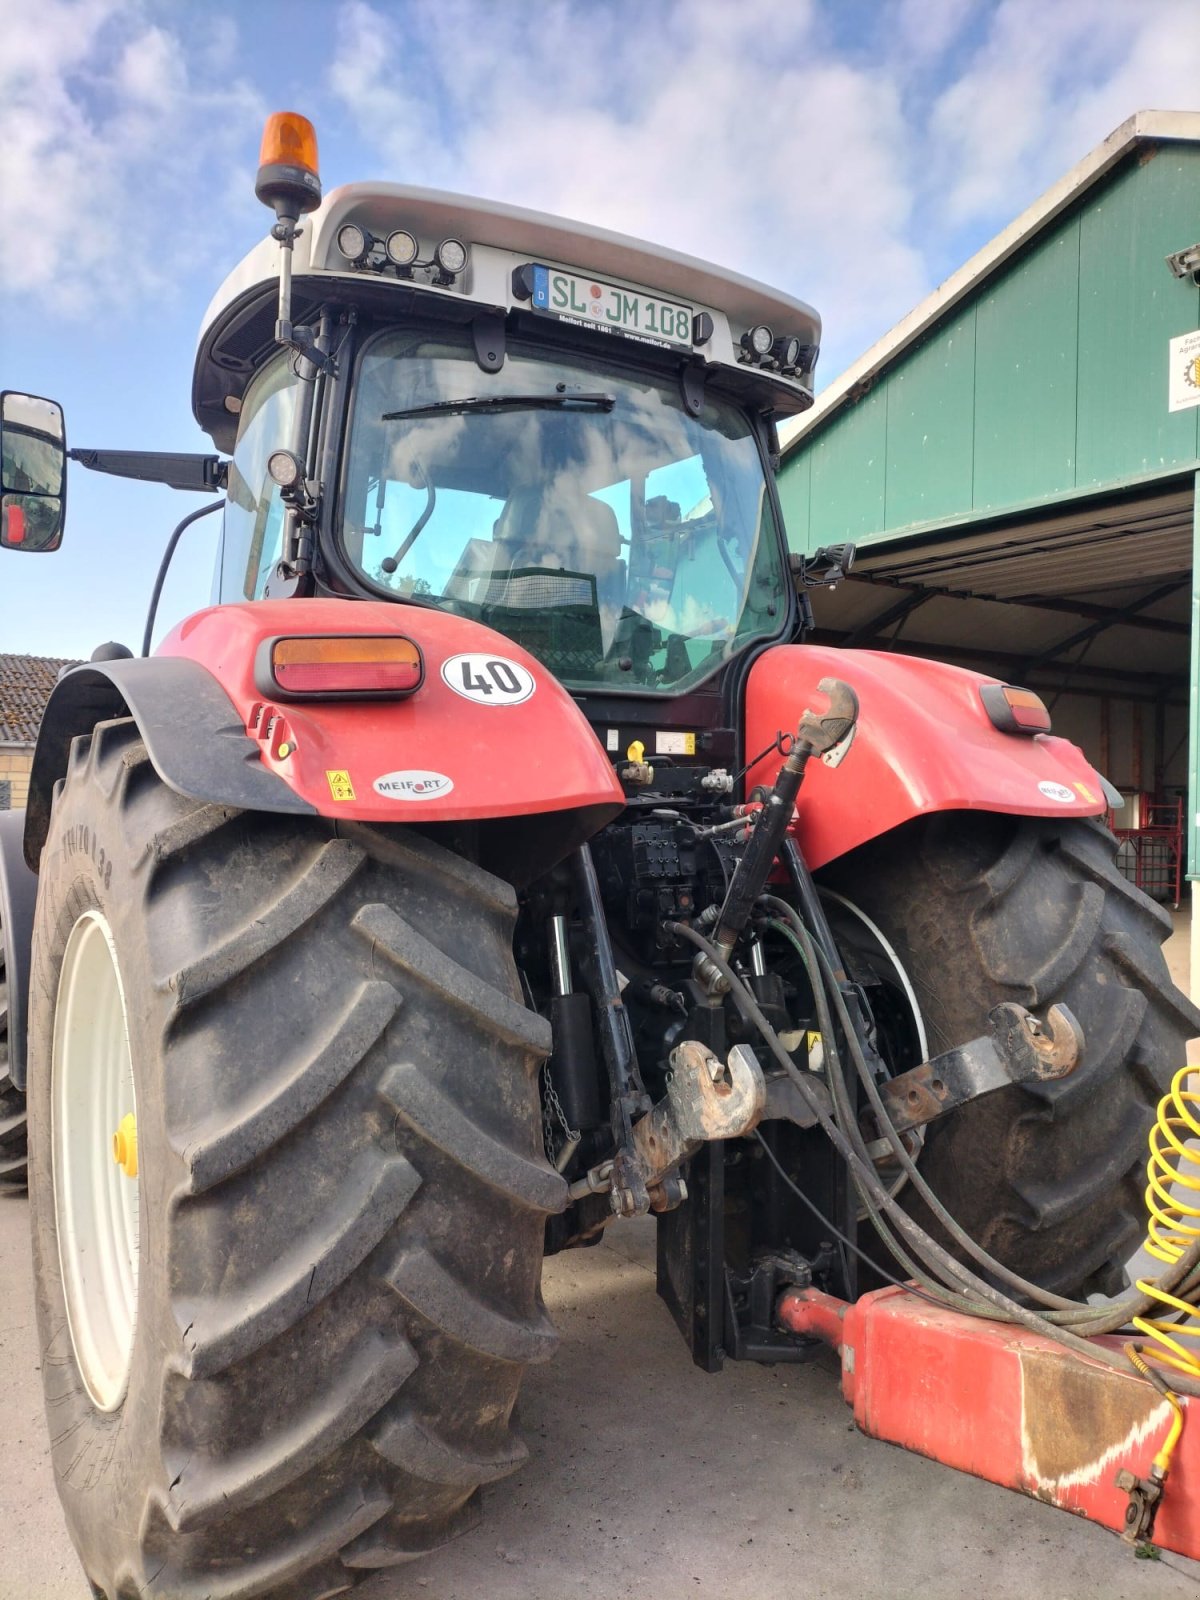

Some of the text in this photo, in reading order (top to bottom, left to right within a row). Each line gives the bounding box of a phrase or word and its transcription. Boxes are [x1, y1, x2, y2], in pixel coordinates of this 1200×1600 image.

[538, 290, 545, 300] D
[552, 276, 689, 340] SL JM 108
[461, 661, 522, 695] 40
